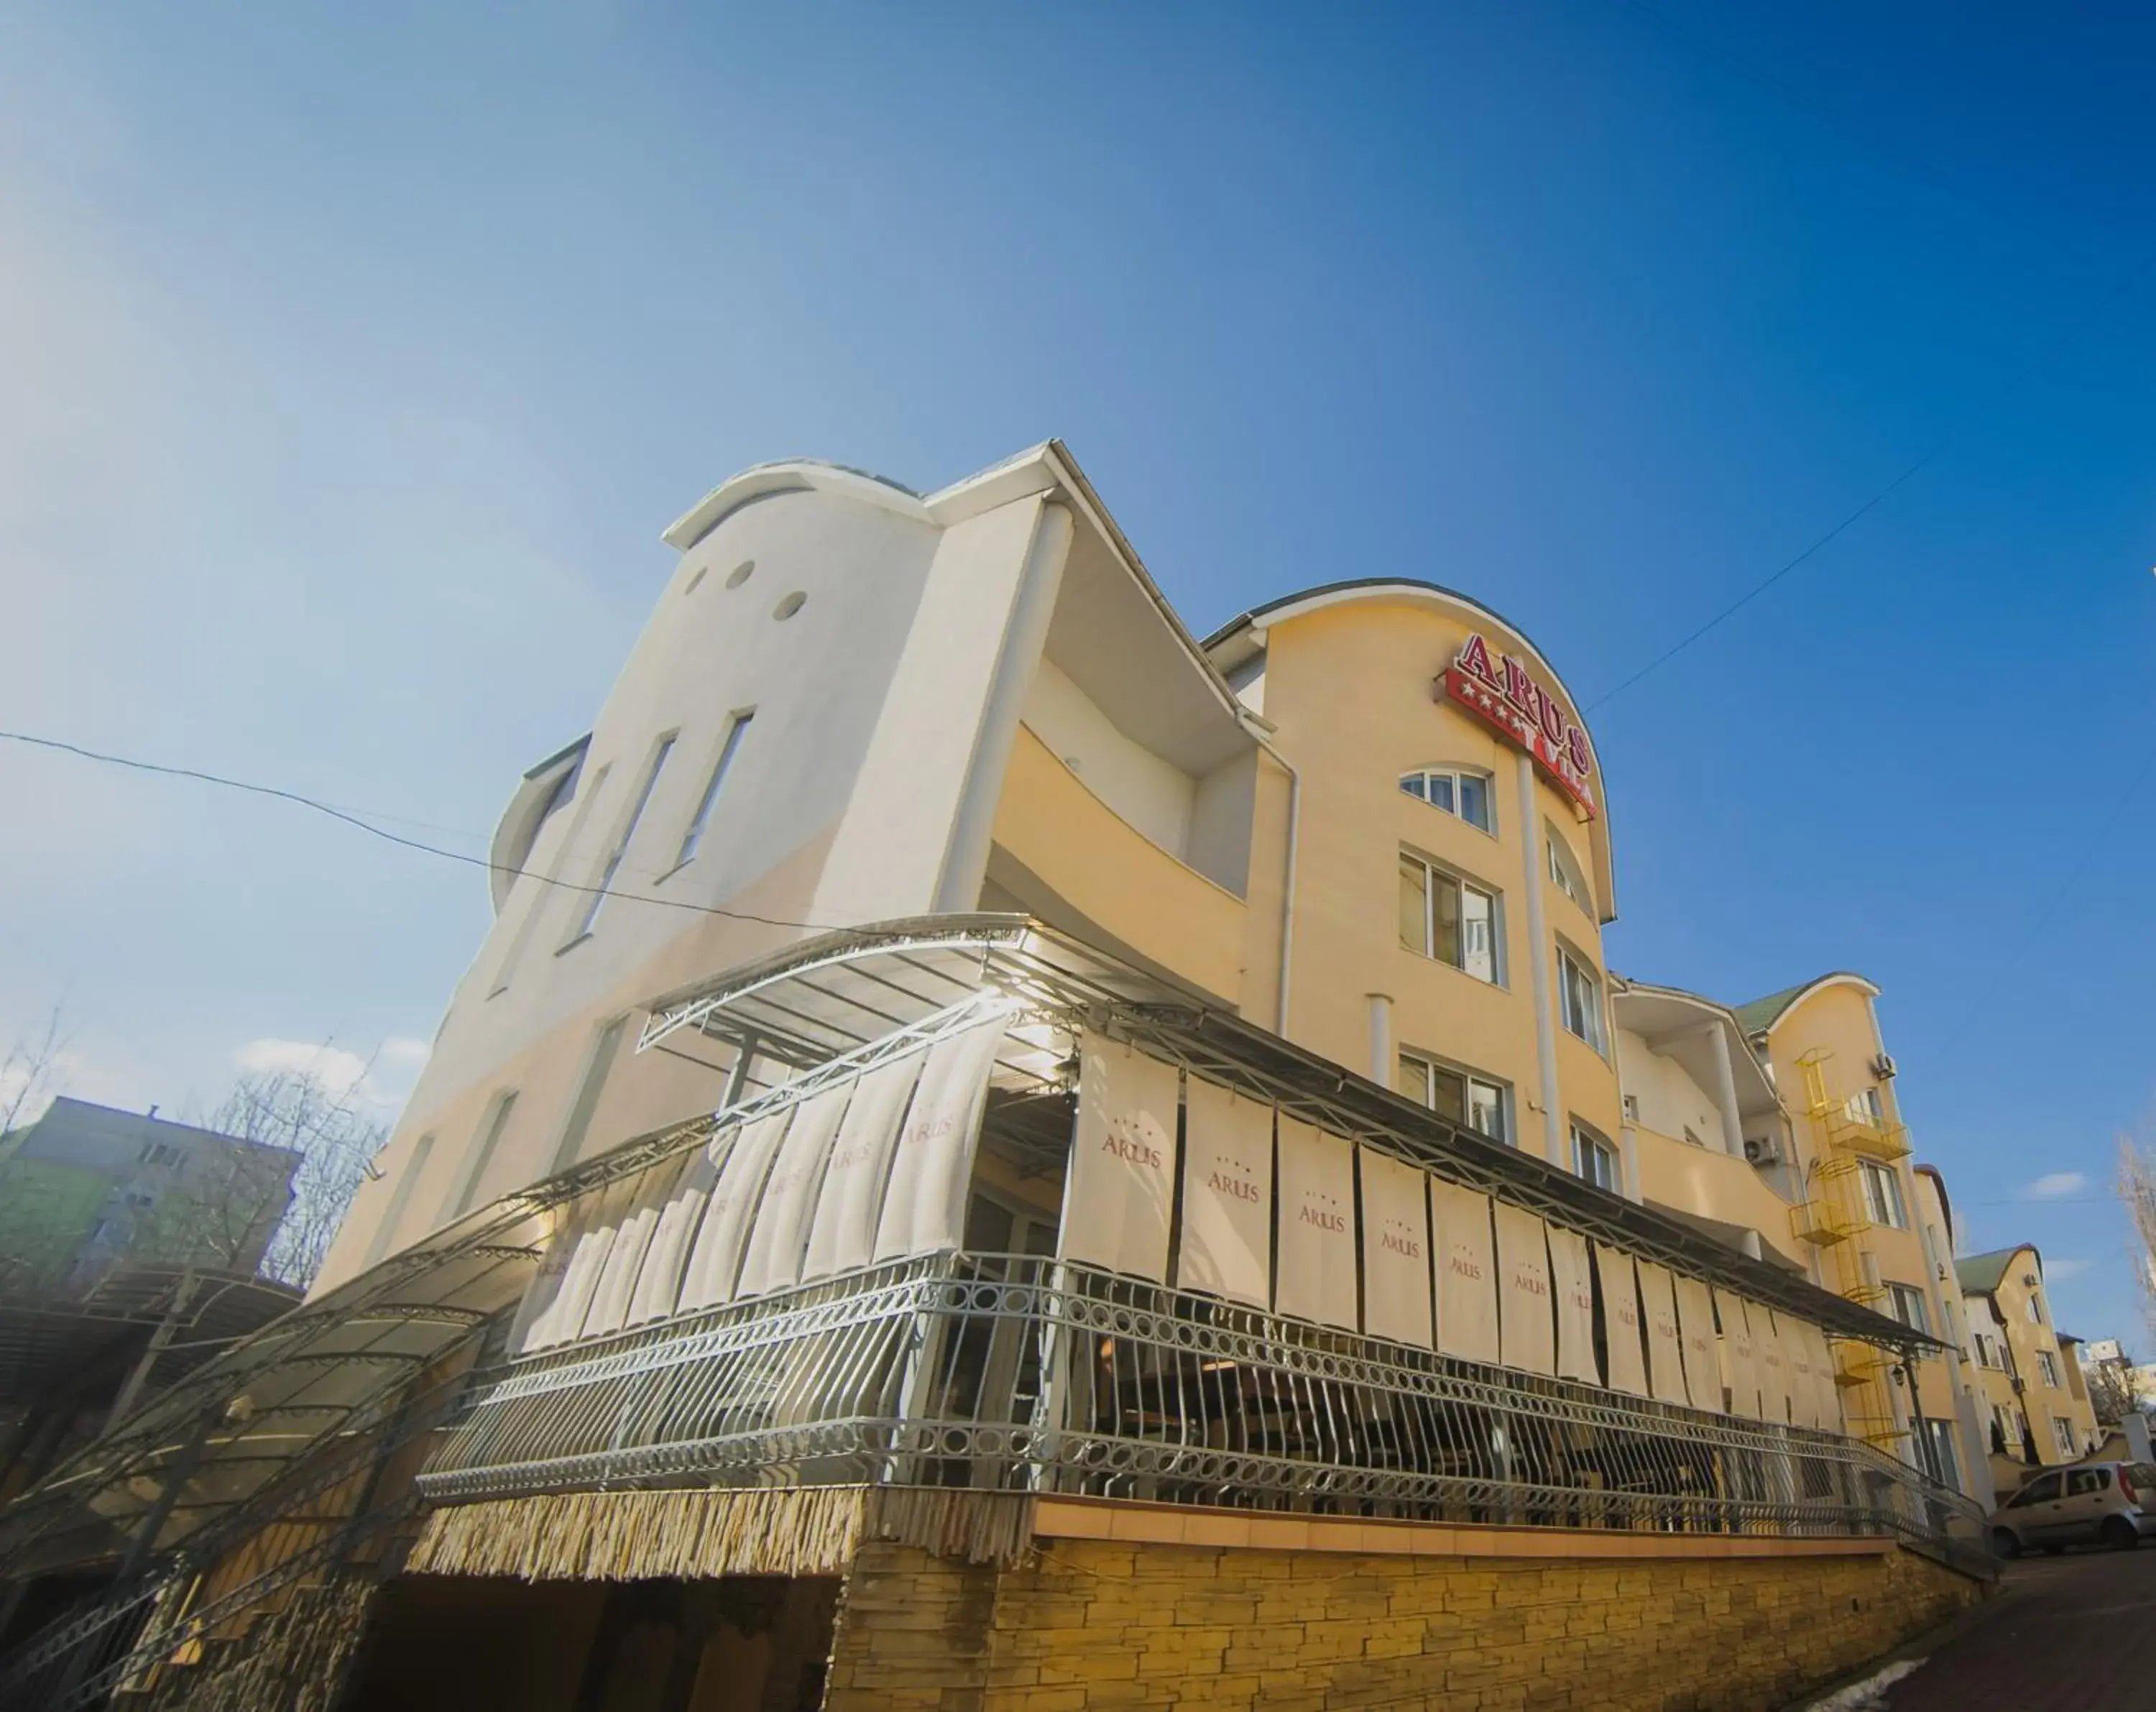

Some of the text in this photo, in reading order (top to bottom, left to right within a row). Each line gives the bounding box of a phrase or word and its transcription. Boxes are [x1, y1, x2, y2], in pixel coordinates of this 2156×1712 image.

[1454, 632, 1590, 778] ARUS
[1102, 1133, 1161, 1170] ARUS
[1207, 1171, 1259, 1204] ARUS
[1299, 1205, 1345, 1233] ARUS
[1381, 1232, 1420, 1258] ARUS
